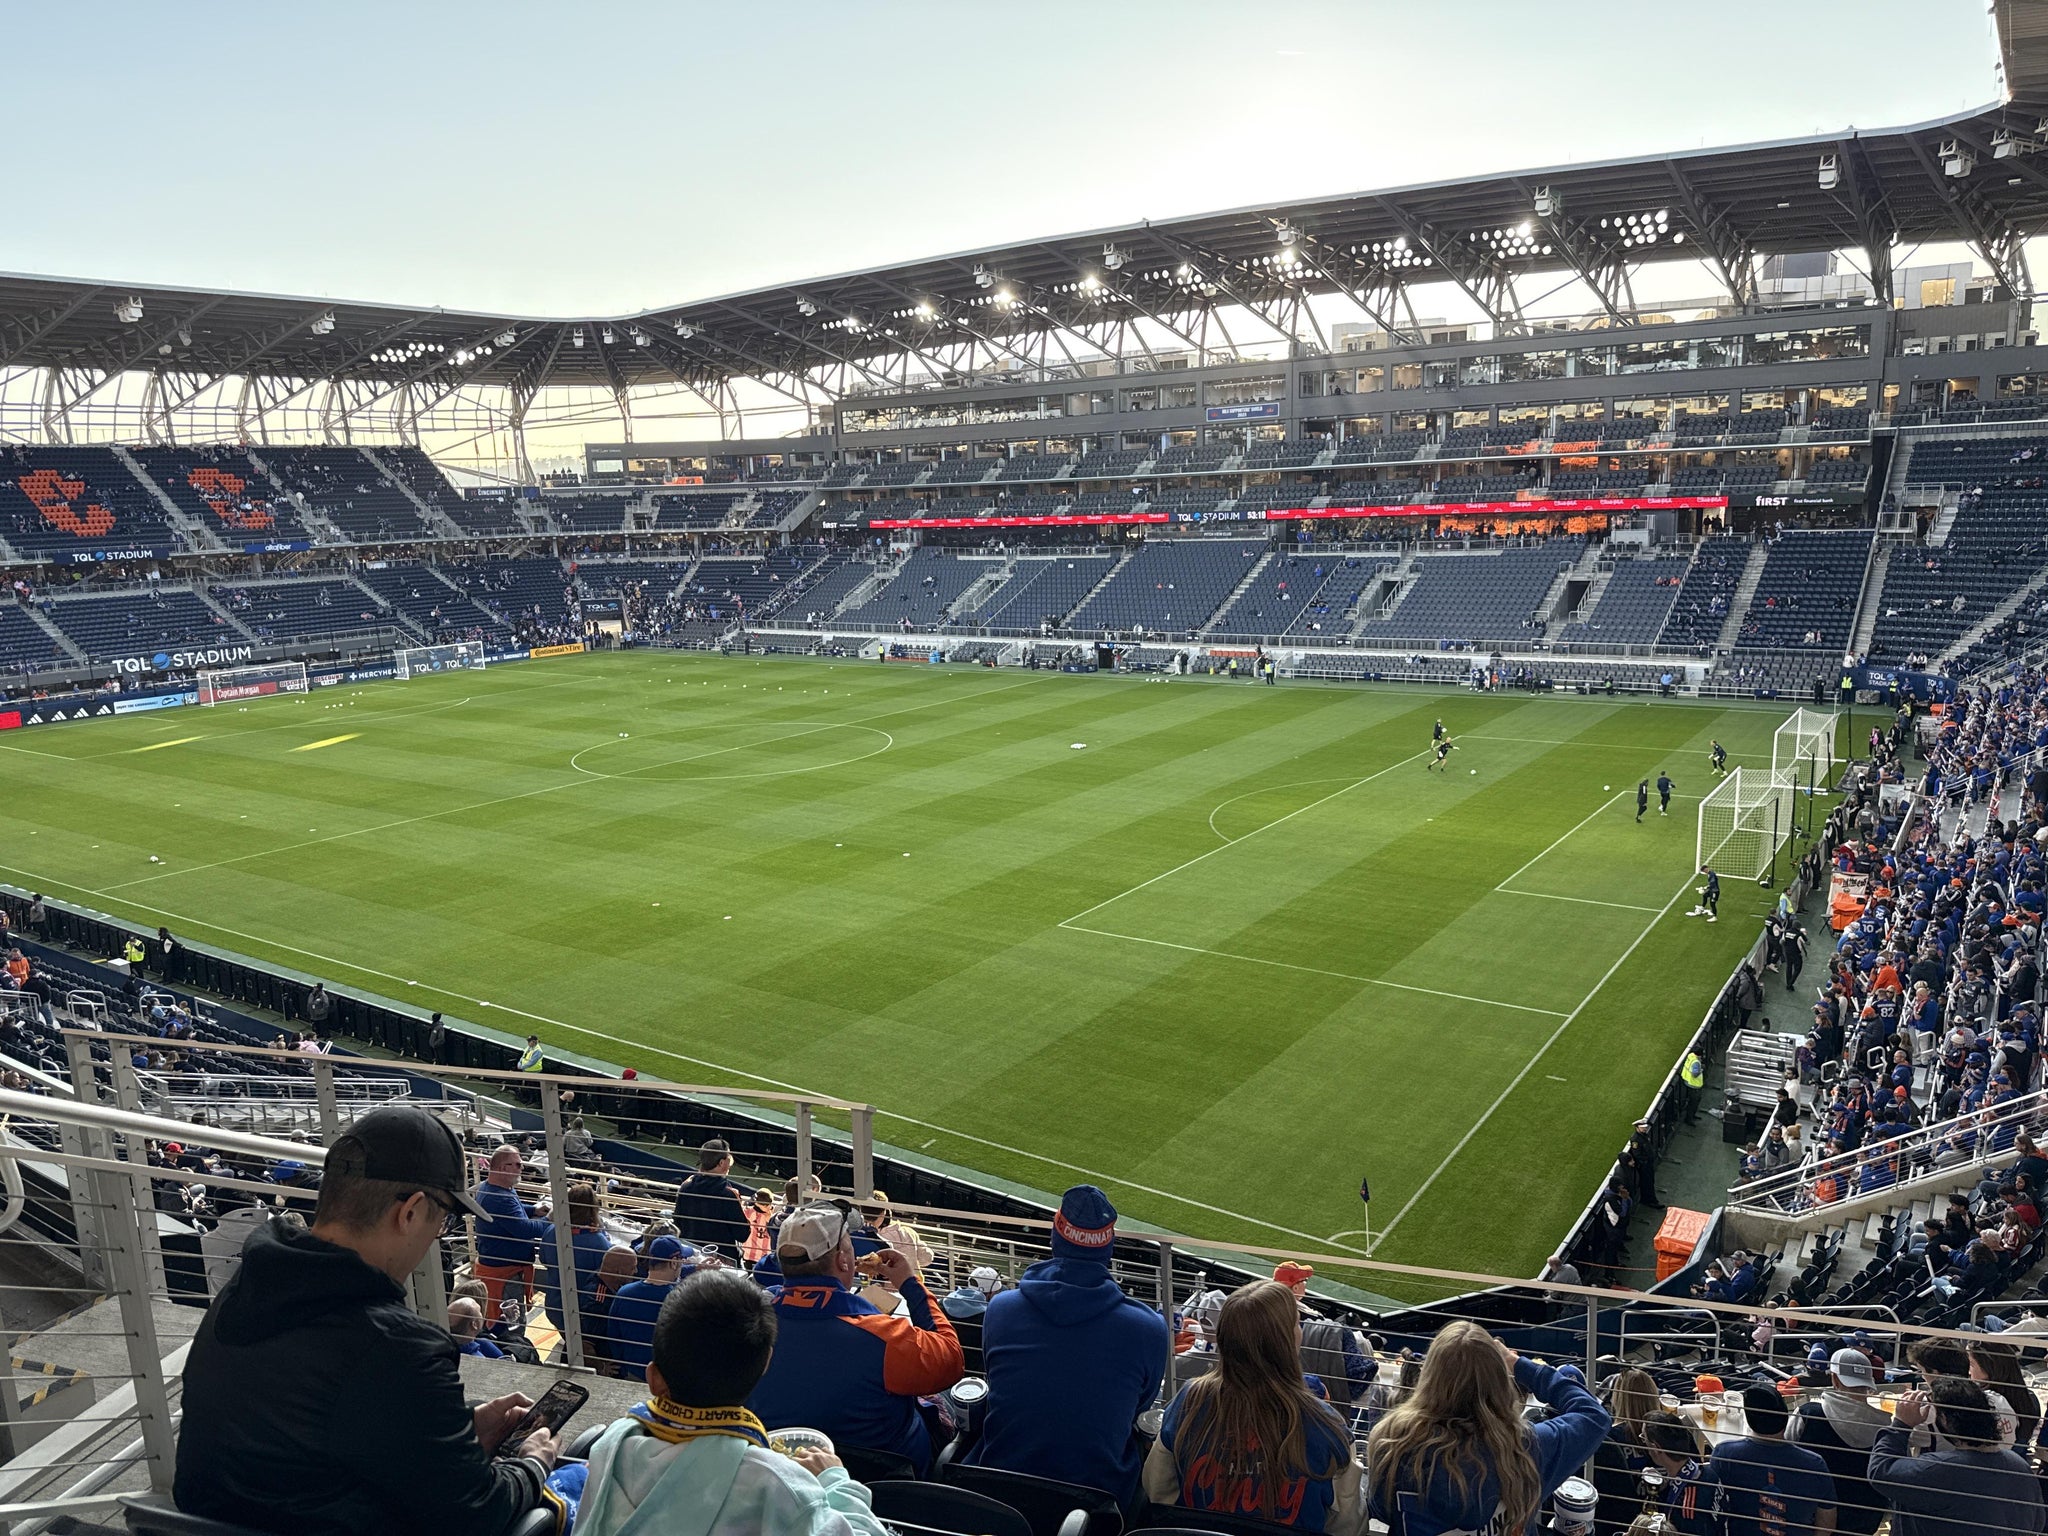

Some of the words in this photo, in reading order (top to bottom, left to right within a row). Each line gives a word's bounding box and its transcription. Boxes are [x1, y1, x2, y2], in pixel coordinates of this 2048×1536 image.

[1177, 513, 1193, 522] TQL
[1203, 512, 1240, 520] STADIUM
[1247, 510, 1266, 519] 53:19
[264, 543, 292, 553] altafiber
[72, 553, 95, 563] TQL
[106, 550, 153, 561] STADIUM
[534, 646, 564, 657] Continental
[112, 658, 151, 674] TQL
[172, 647, 252, 667] STADIUM
[445, 660, 462, 669] TQL
[414, 664, 432, 673] TQL
[1869, 672, 1886, 680] TQL
[217, 687, 239, 699] Captain
[240, 685, 260, 696] Morgan
[1862, 924, 1874, 933] 10
[1880, 1007, 1894, 1018] 82
[660, 1401, 694, 1420] CHOICE
[696, 1409, 741, 1421] SMART
[743, 1415, 761, 1427] THE
